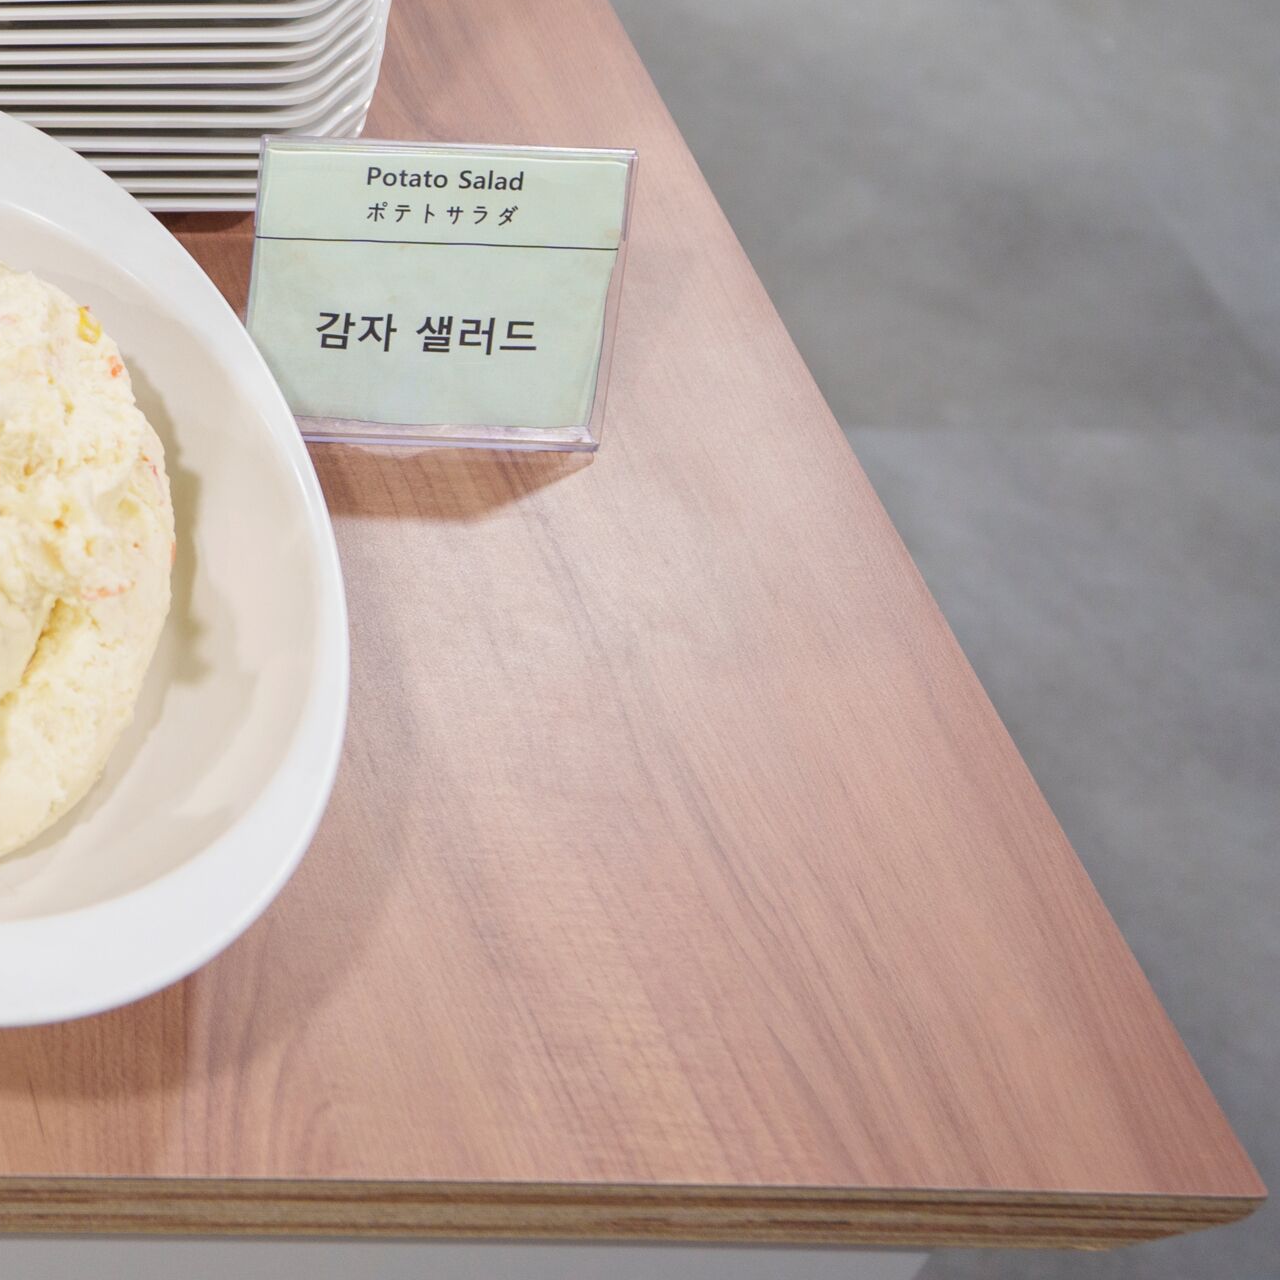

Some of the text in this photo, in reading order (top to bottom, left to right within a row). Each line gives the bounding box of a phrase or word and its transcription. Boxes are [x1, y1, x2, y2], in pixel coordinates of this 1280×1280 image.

[366, 166, 524, 192] Potato Salad
[367, 202, 519, 226] ポテトサラダ
[315, 312, 538, 355] 감자 샐러드
